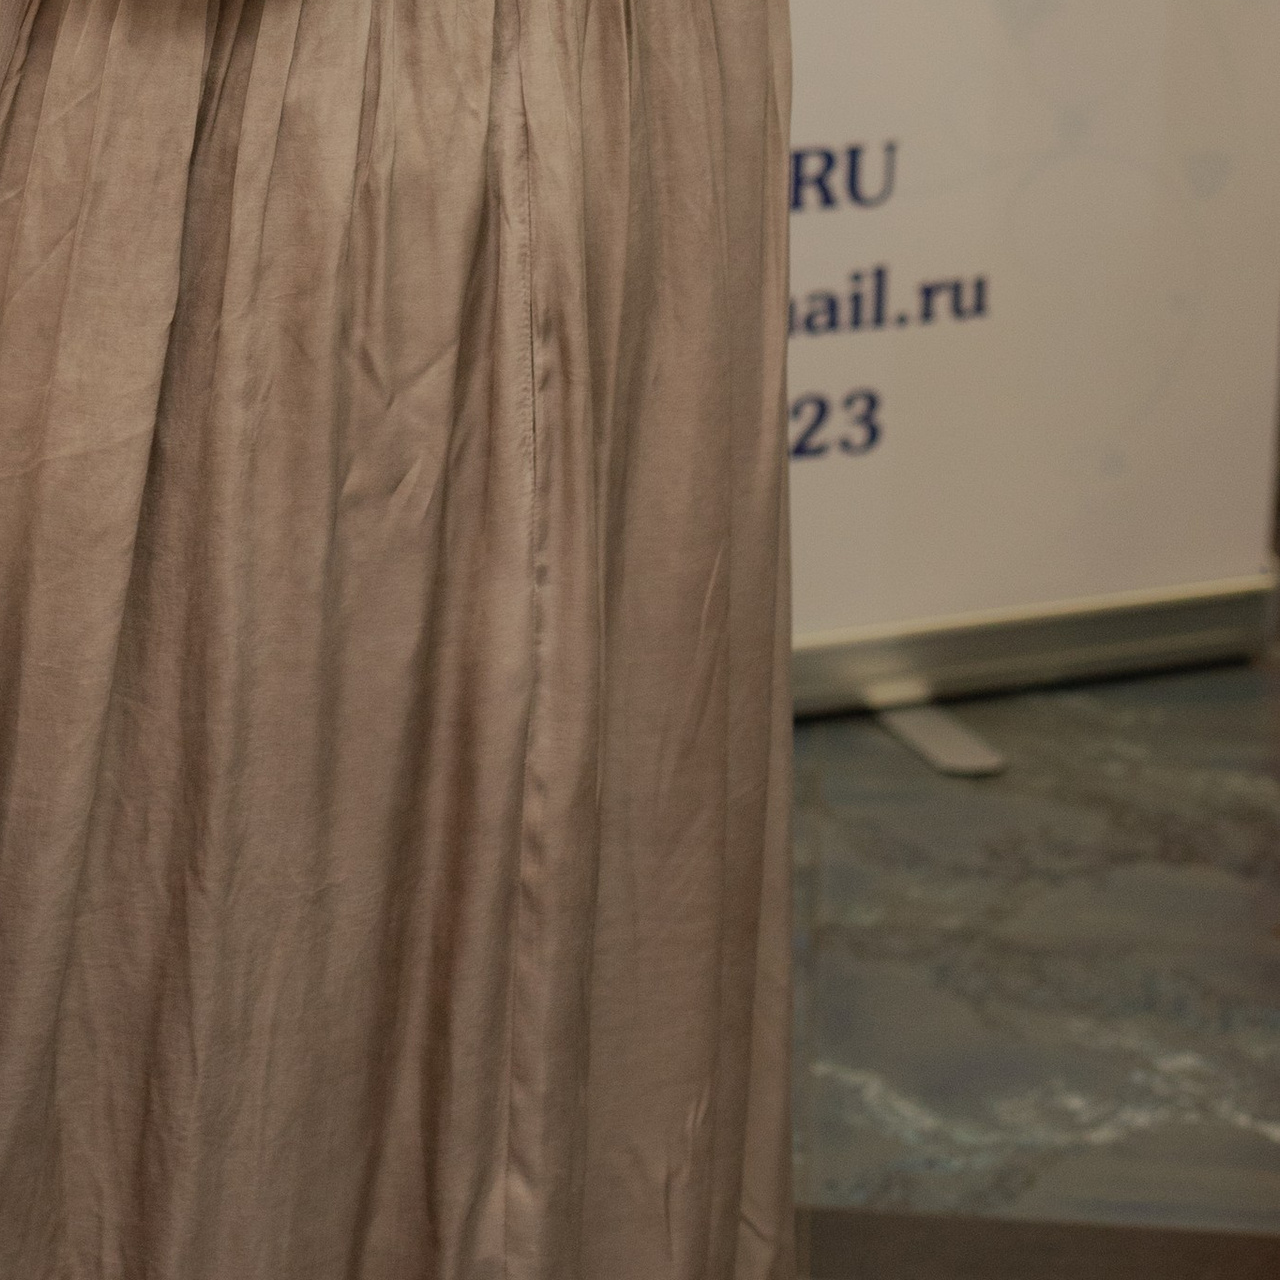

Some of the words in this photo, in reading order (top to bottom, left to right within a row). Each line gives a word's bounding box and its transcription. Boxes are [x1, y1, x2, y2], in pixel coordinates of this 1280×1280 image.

[790, 142, 898, 212] RU
[789, 263, 990, 337] ail.ru
[788, 388, 883, 461] 23
